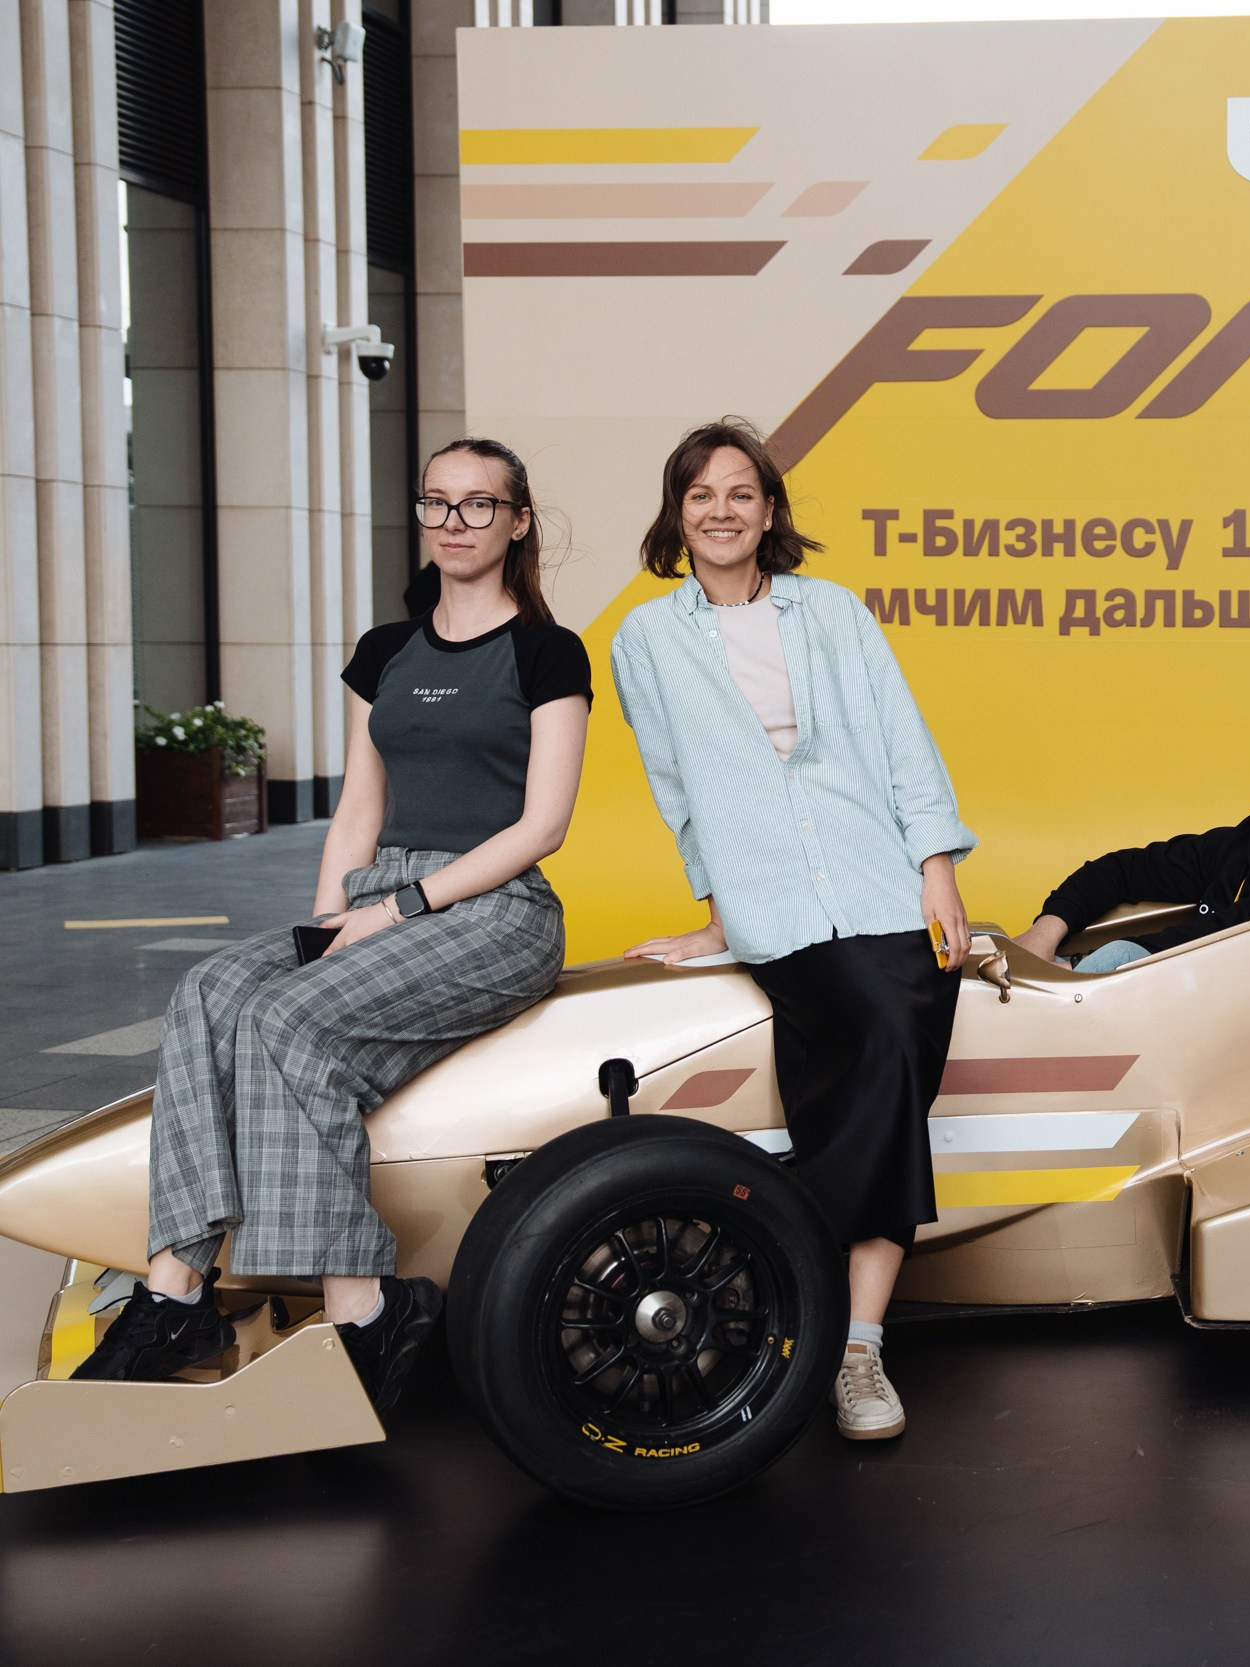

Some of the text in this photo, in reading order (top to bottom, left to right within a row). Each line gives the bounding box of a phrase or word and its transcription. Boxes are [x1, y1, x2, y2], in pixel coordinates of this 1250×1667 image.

[861, 507, 1194, 572] Т-Бизнесу
[864, 587, 1045, 628] мчим
[412, 687, 459, 696] SAN DIEGO
[634, 1442, 701, 1458] RACING
